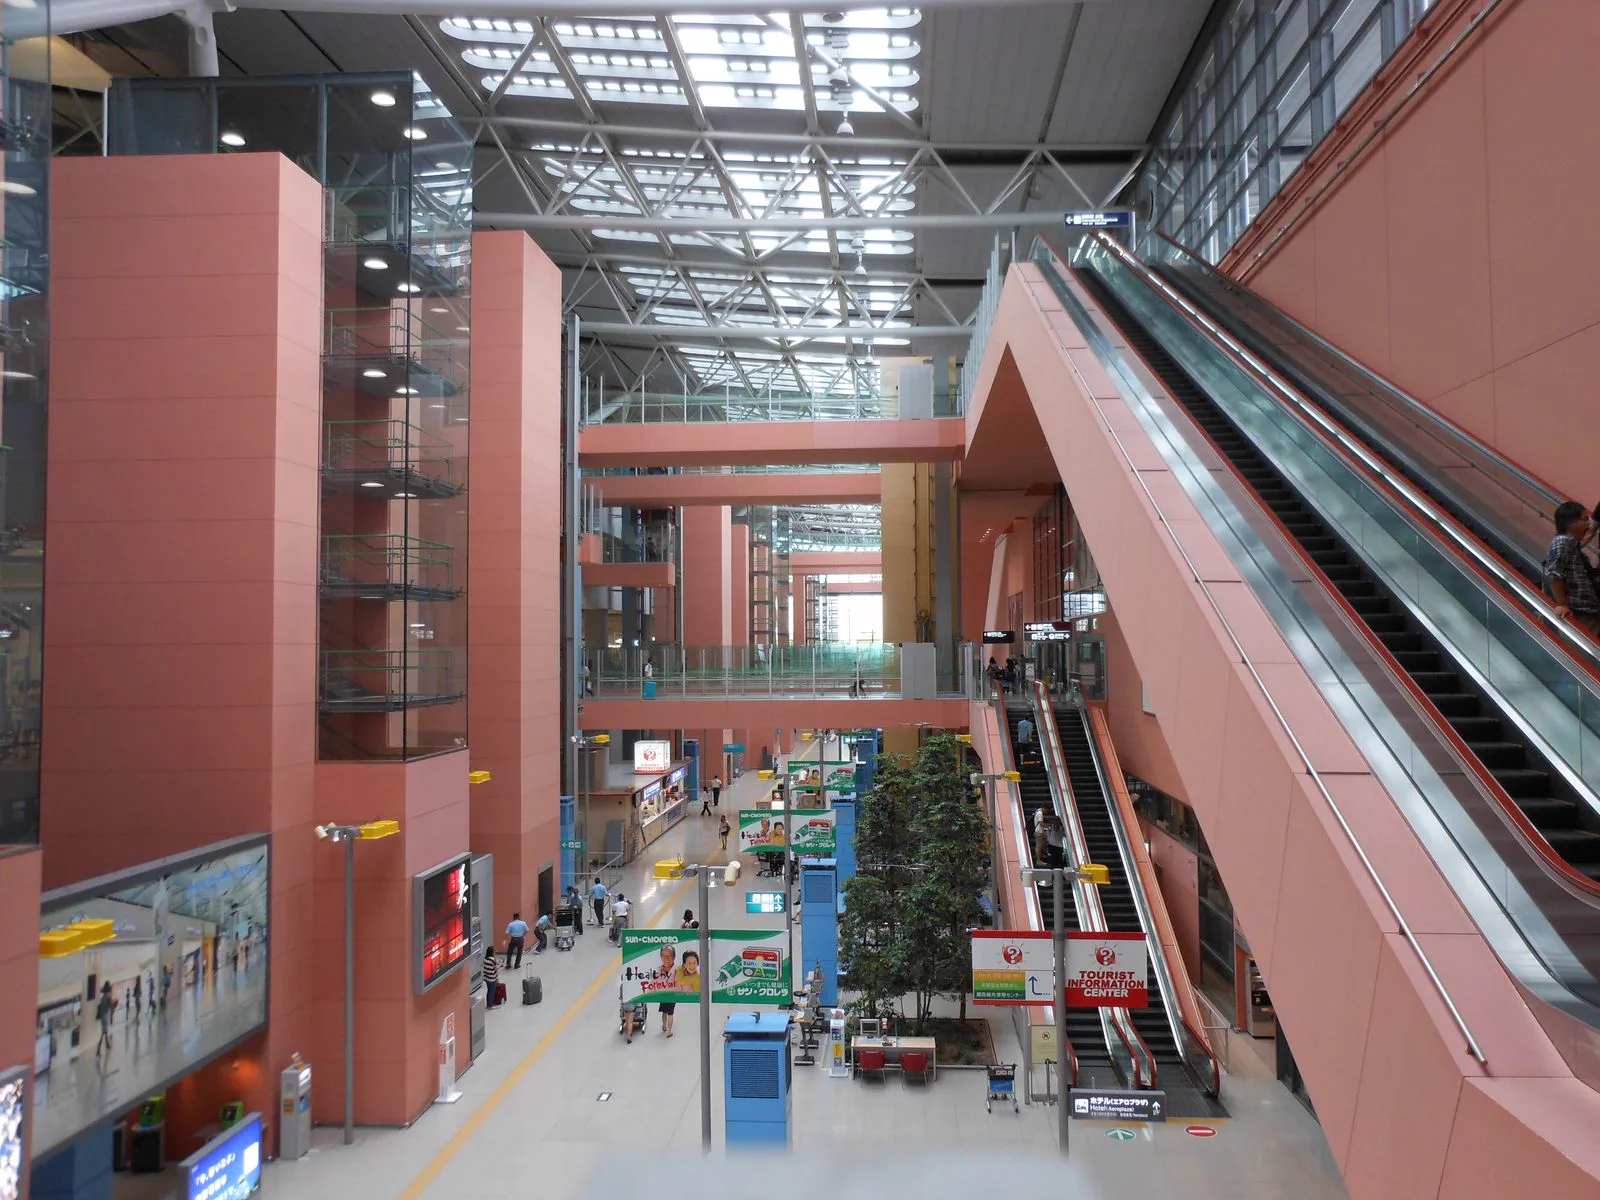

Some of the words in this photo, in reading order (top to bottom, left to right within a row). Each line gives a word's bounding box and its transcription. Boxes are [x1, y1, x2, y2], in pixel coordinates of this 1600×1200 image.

[1079, 970, 1135, 980] TOURIST
[1067, 979, 1145, 989] INFORMATION
[1083, 988, 1129, 998] CENTER
